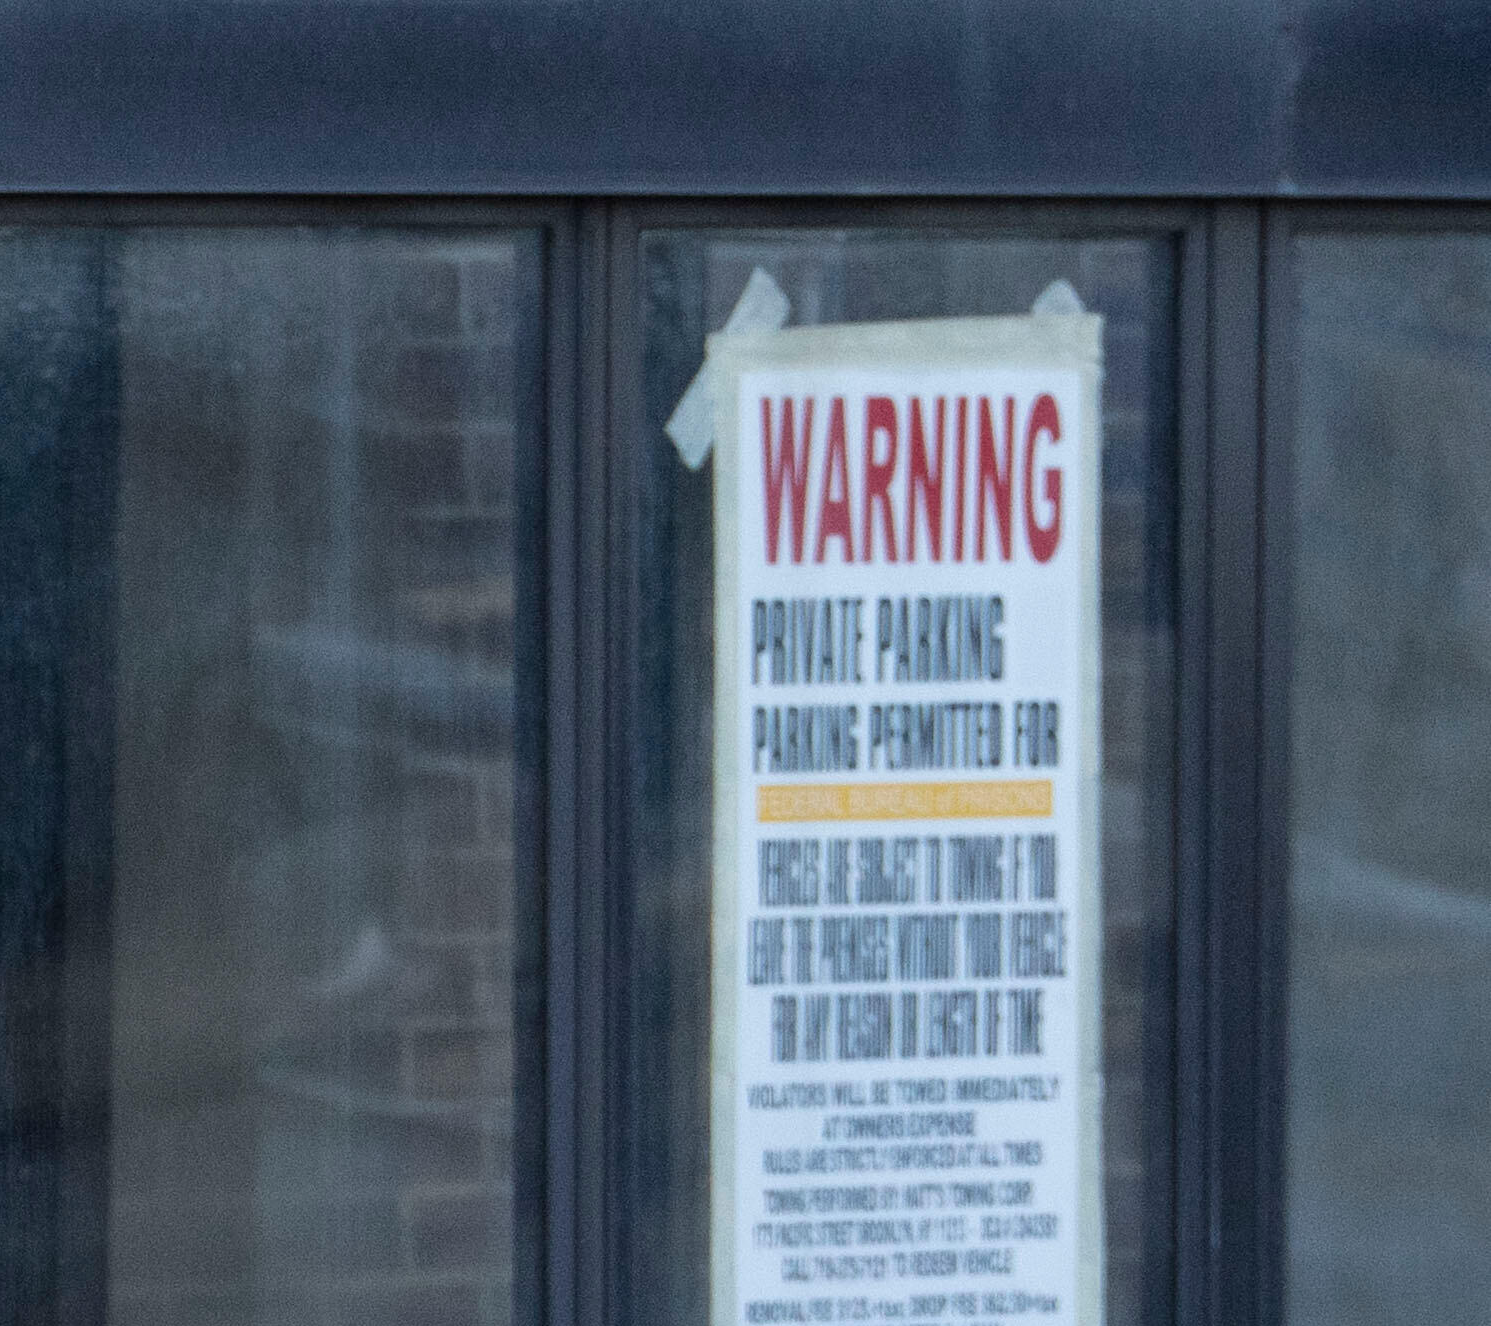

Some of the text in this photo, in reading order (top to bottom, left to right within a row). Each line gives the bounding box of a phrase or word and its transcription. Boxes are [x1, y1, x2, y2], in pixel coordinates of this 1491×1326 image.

[760, 393, 1063, 565] WARNING
[752, 595, 1004, 684] PRIVATE PARKING
[752, 700, 1061, 773] PARKING PERMITTED FOR
